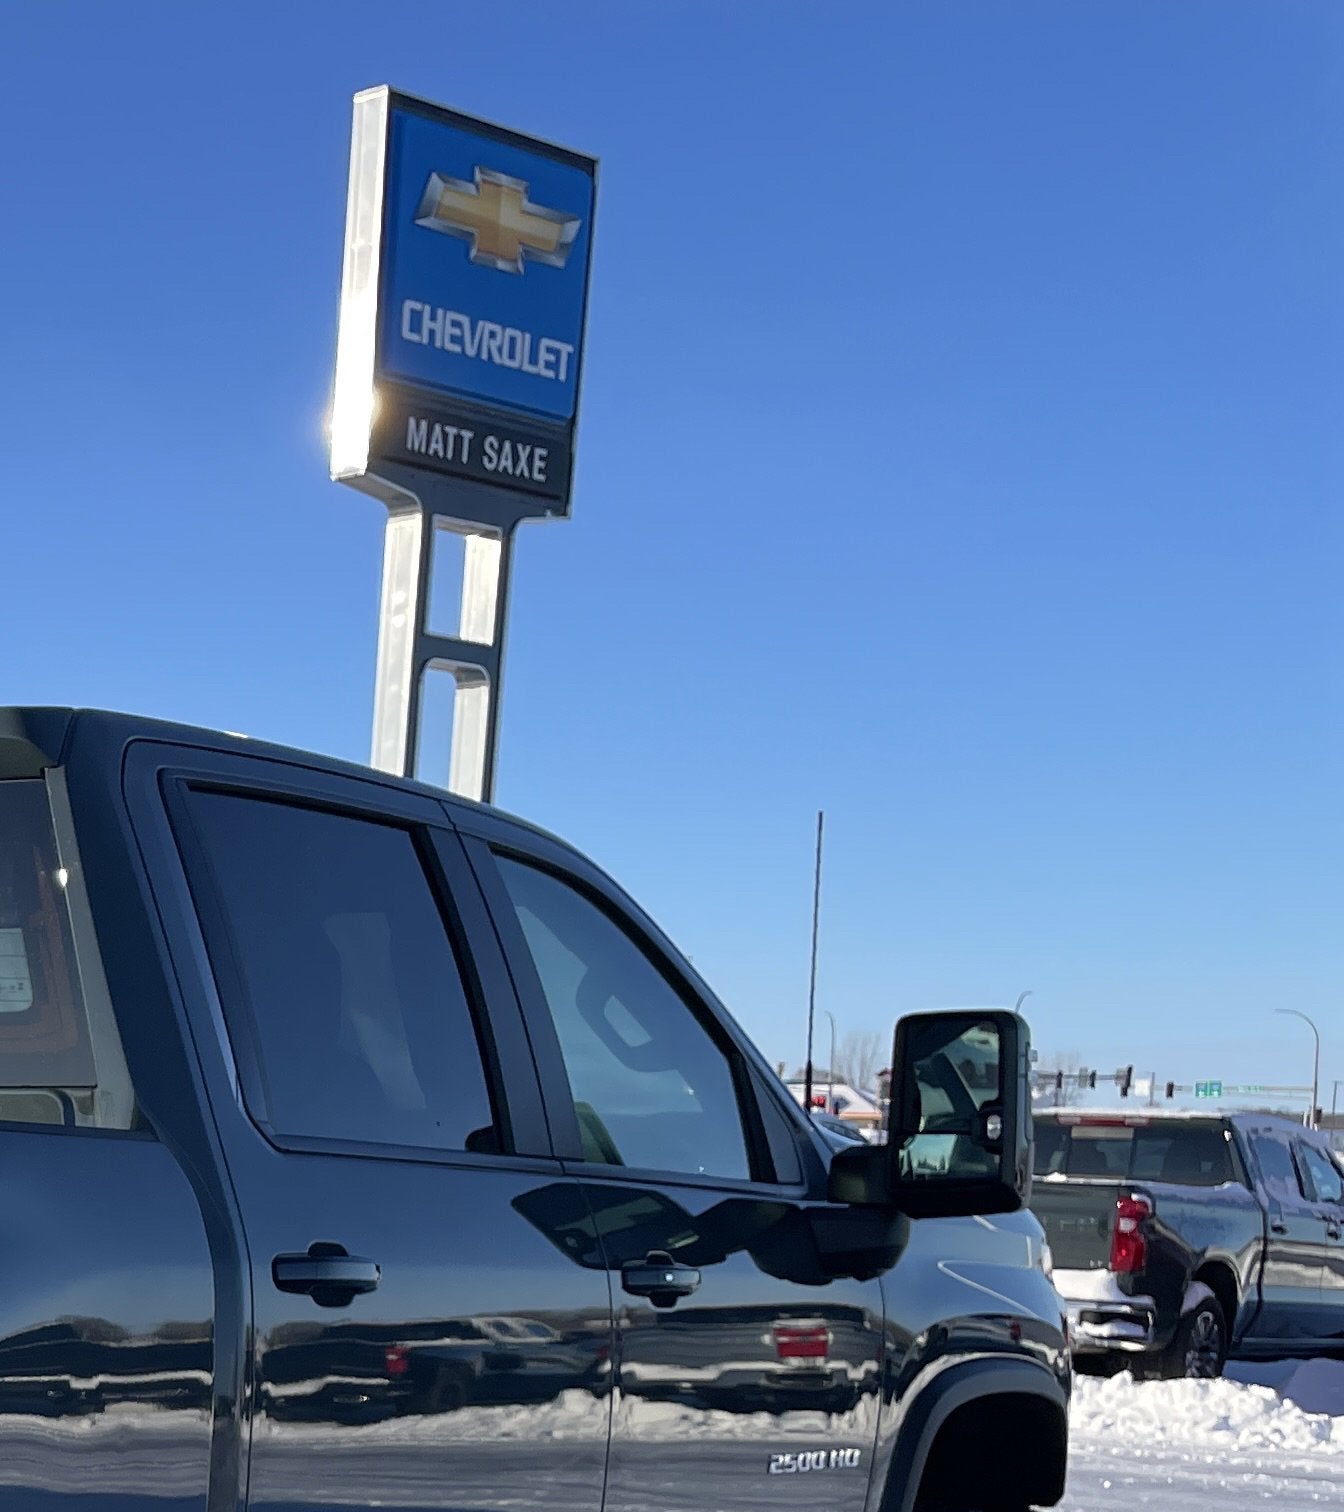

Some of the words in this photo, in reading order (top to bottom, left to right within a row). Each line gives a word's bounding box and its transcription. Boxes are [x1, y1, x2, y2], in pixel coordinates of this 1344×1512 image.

[401, 299, 574, 383] CHEVROLET
[406, 416, 475, 464] MATT
[482, 436, 549, 483] SAXE
[769, 1450, 827, 1474] 2500
[829, 1448, 861, 1468] HD
